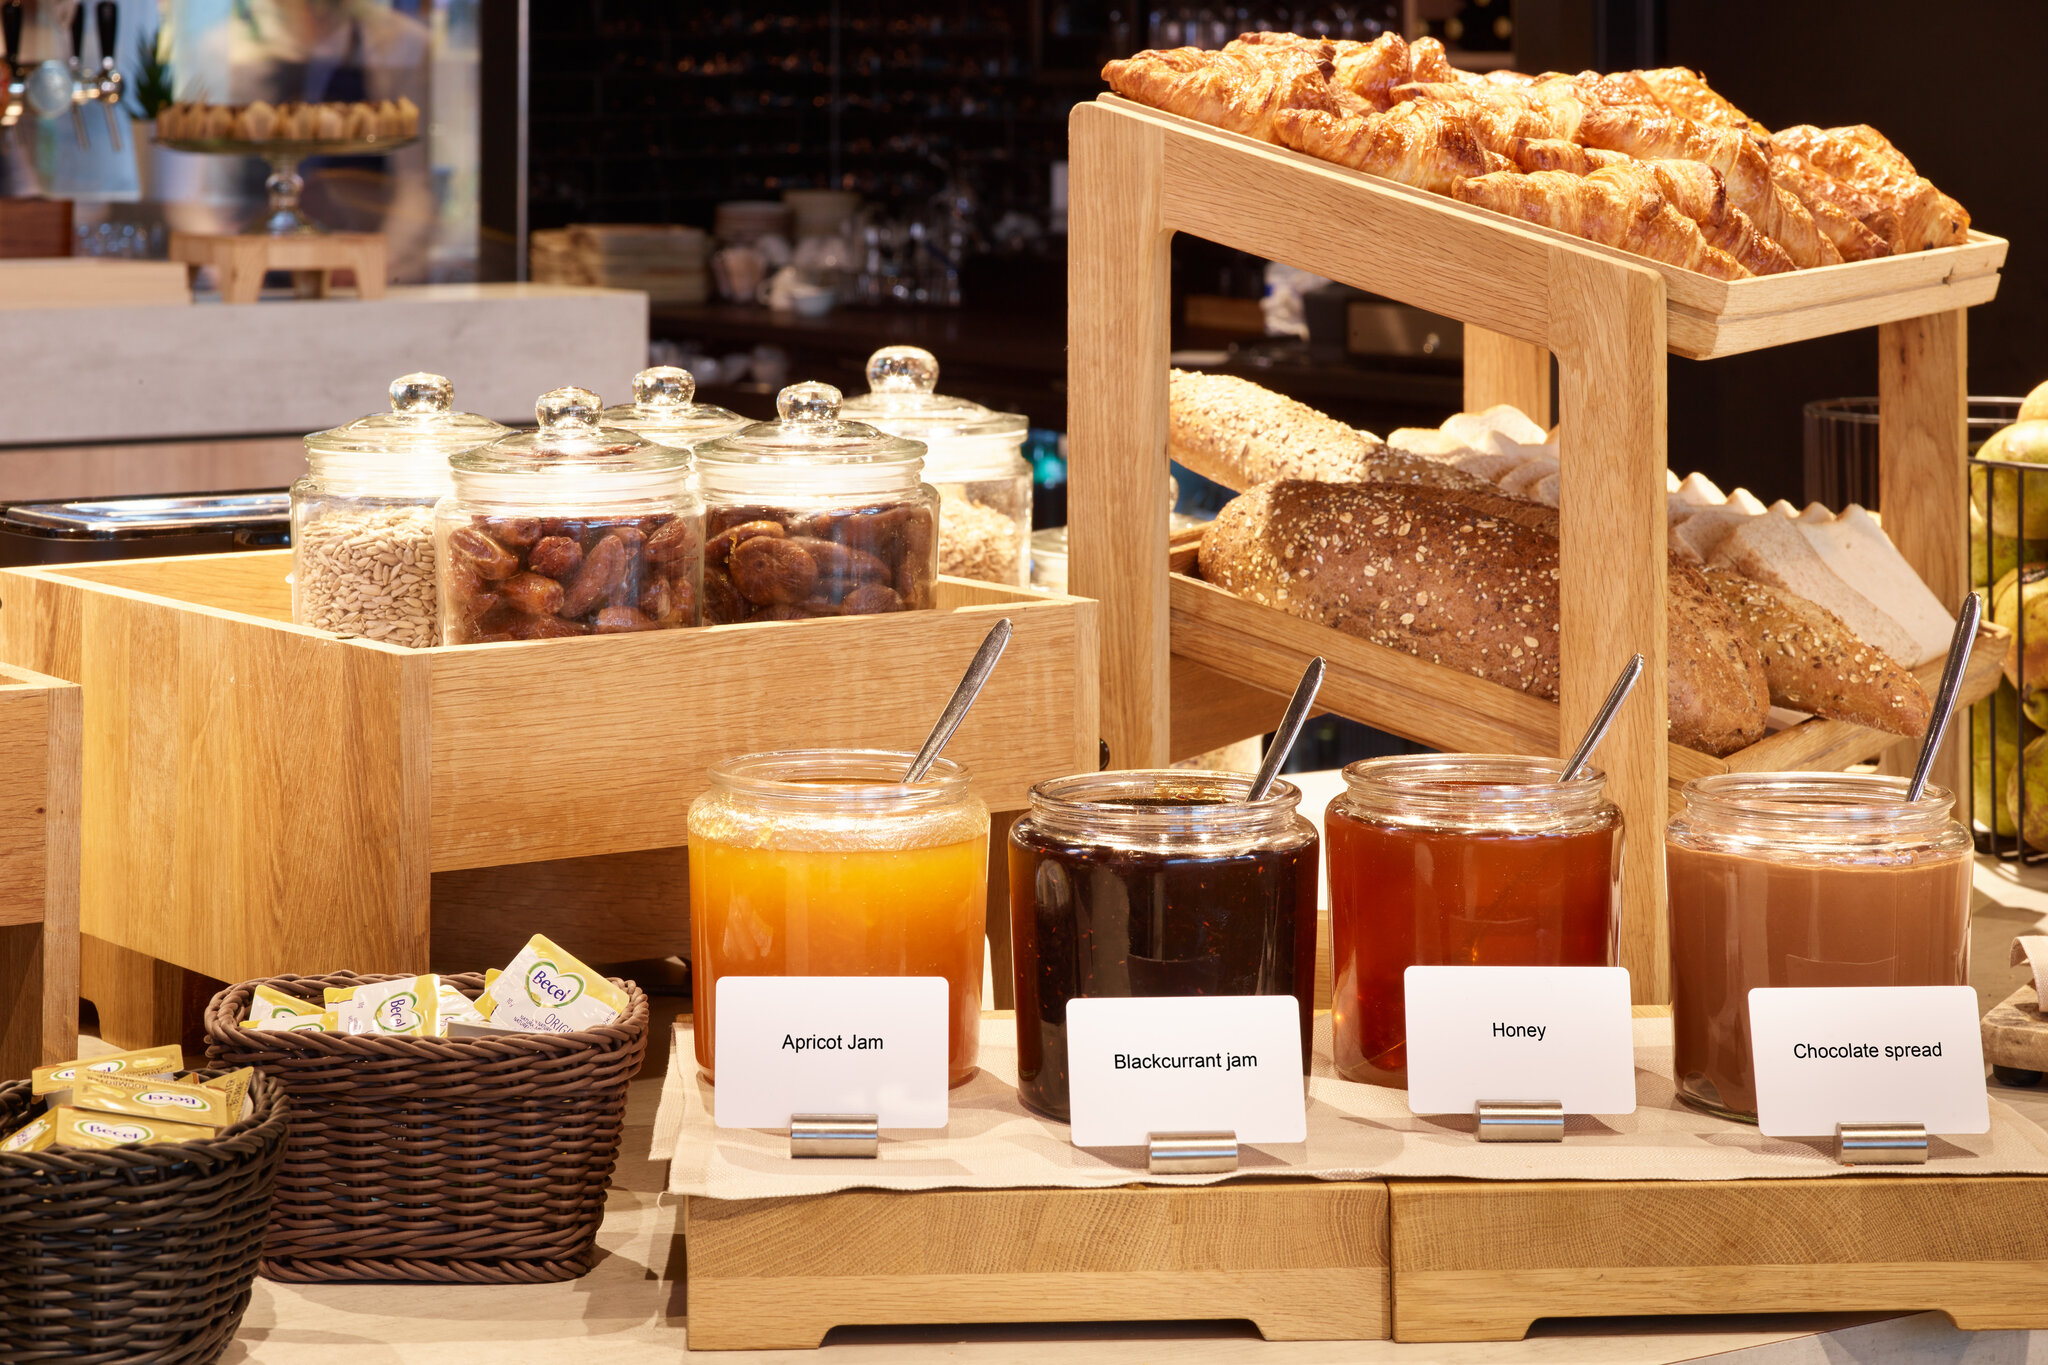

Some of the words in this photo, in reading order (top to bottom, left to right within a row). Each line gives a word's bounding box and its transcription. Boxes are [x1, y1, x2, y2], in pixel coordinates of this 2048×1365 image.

[532, 970, 571, 1002] Becel
[1492, 1022, 1547, 1042] Honey
[781, 1033, 843, 1054] Apricot
[847, 1034, 884, 1050] Jam
[1793, 1042, 1880, 1059] Chocolate
[1884, 1041, 1943, 1062] spread
[1114, 1052, 1223, 1071] Blackcurrant
[1225, 1053, 1258, 1072] jam
[148, 1094, 196, 1106] Becel
[90, 1125, 137, 1139] Becel
